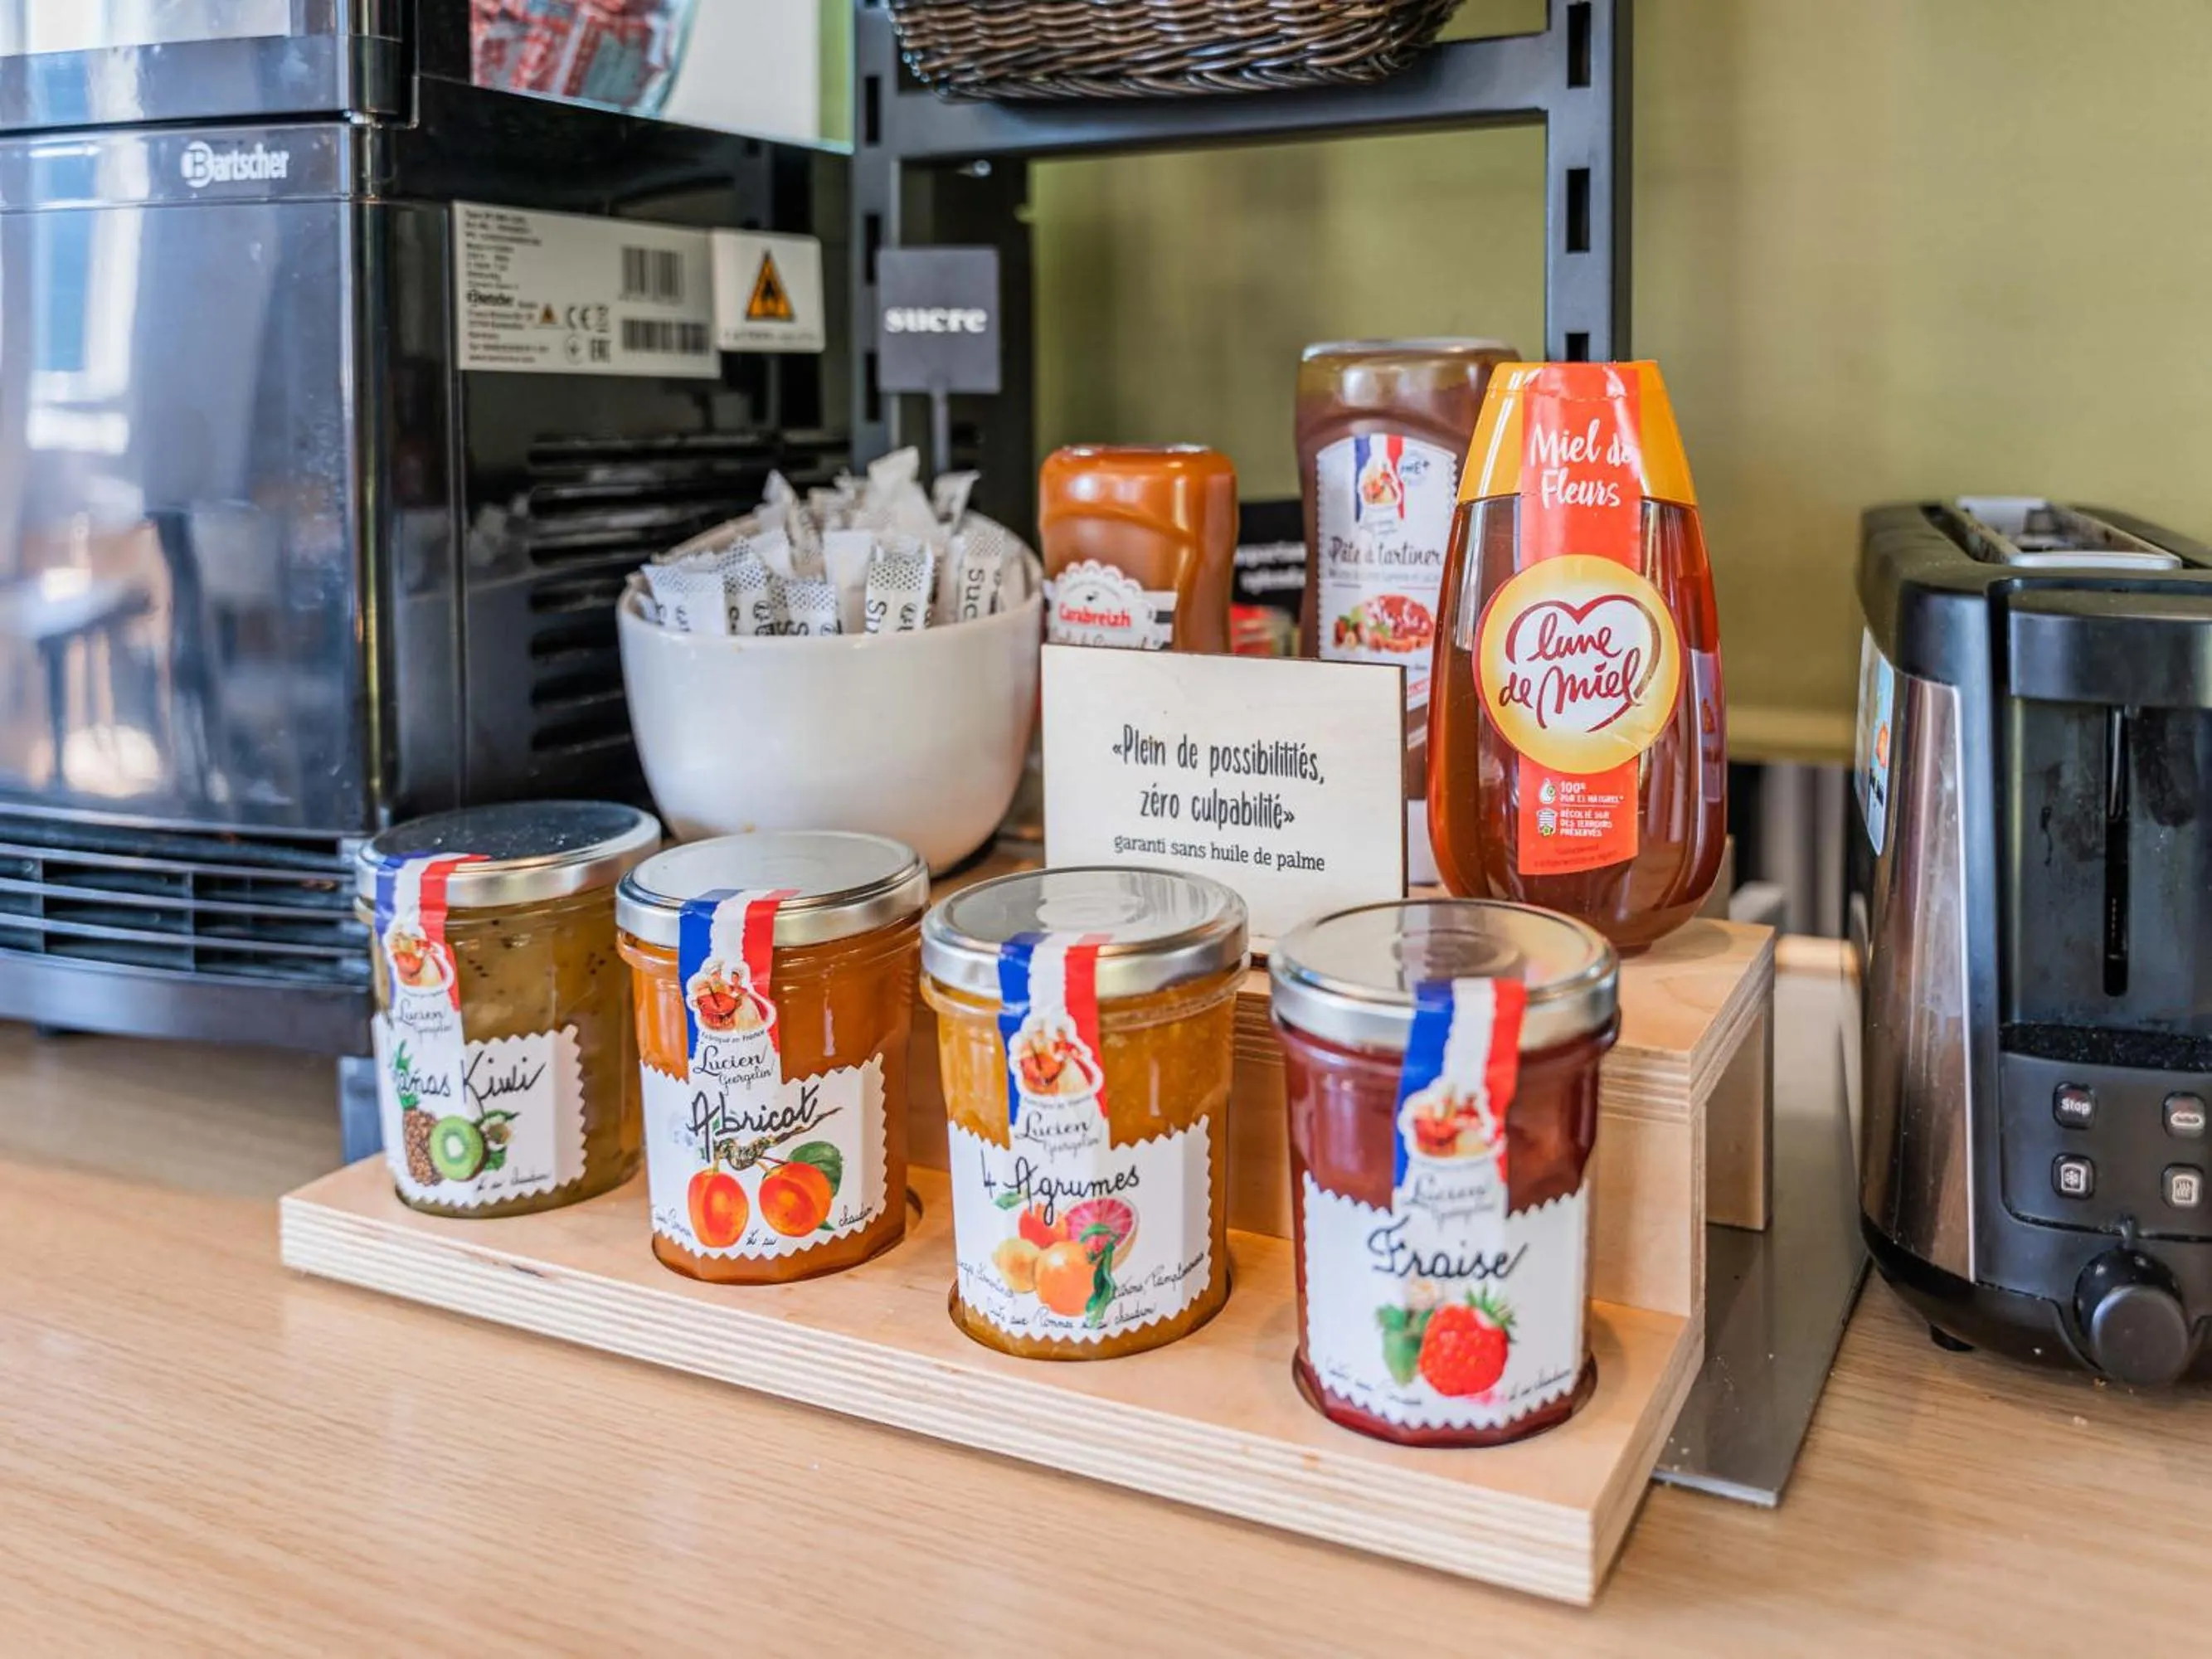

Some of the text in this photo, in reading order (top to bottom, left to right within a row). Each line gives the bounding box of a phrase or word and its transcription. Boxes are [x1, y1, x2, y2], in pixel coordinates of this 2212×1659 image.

[181, 140, 289, 188] Bartscher
[885, 307, 988, 333] sucre
[1529, 418, 1602, 468] Miel
[1540, 467, 1621, 509] Fleurs
[1378, 541, 1442, 566] tartiner
[1498, 672, 1534, 708] de
[1176, 733, 1198, 769] de
[1140, 782, 1296, 830] zéro culpabilité»
[1114, 834, 1325, 872] garanti sans huile de palme
[692, 1044, 768, 1077] Lucien
[460, 1049, 547, 1117] Kiwi
[2061, 1097, 2093, 1116] Stop
[1014, 1110, 1093, 1143] Lucien
[980, 1148, 1140, 1227] 4 Agrumes
[1367, 1214, 1529, 1279] Fraise
